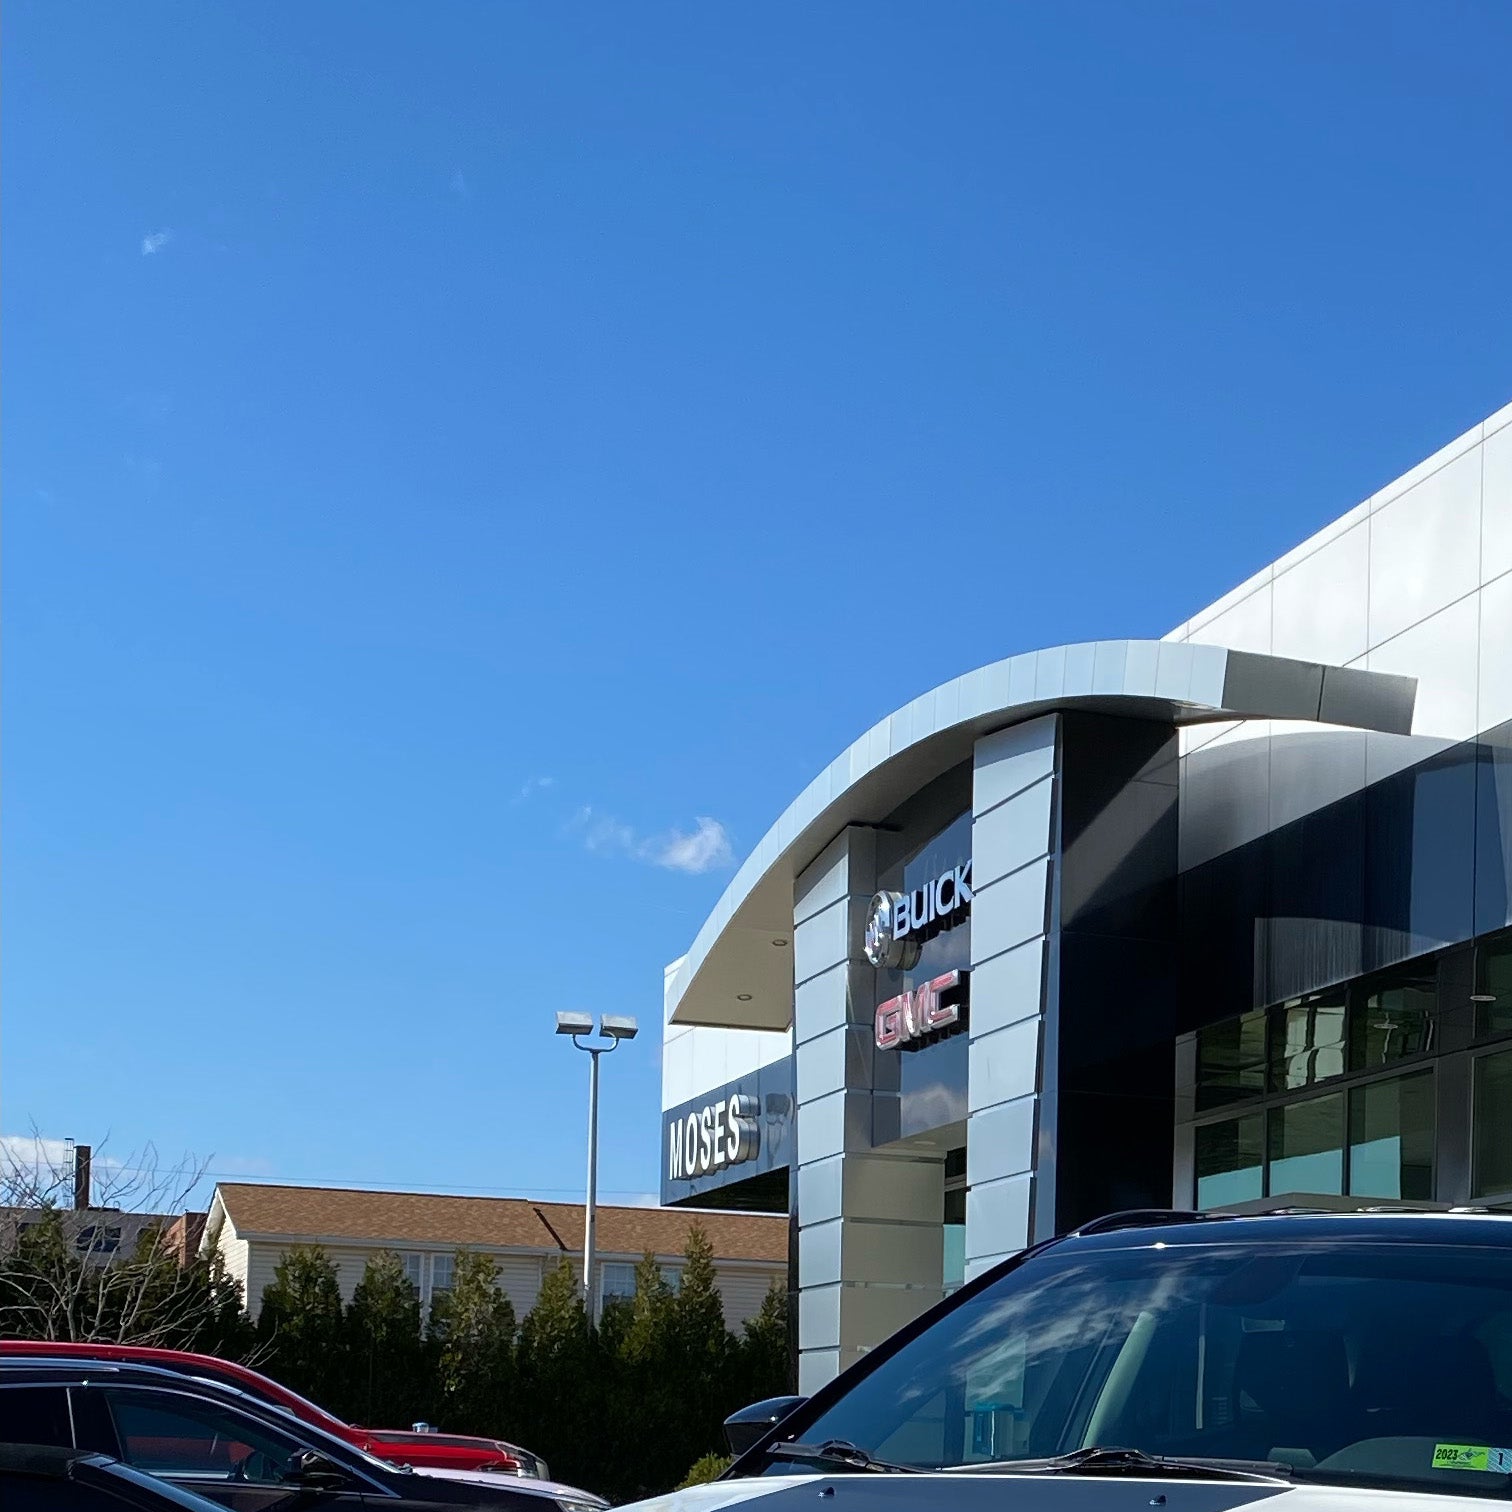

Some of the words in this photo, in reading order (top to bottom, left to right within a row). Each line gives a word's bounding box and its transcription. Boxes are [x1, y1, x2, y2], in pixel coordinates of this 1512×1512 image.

[893, 859, 975, 941] BUICK
[875, 969, 960, 1050] GMC
[669, 1094, 741, 1180] MOSES
[1436, 1449, 1458, 1460] 2023
